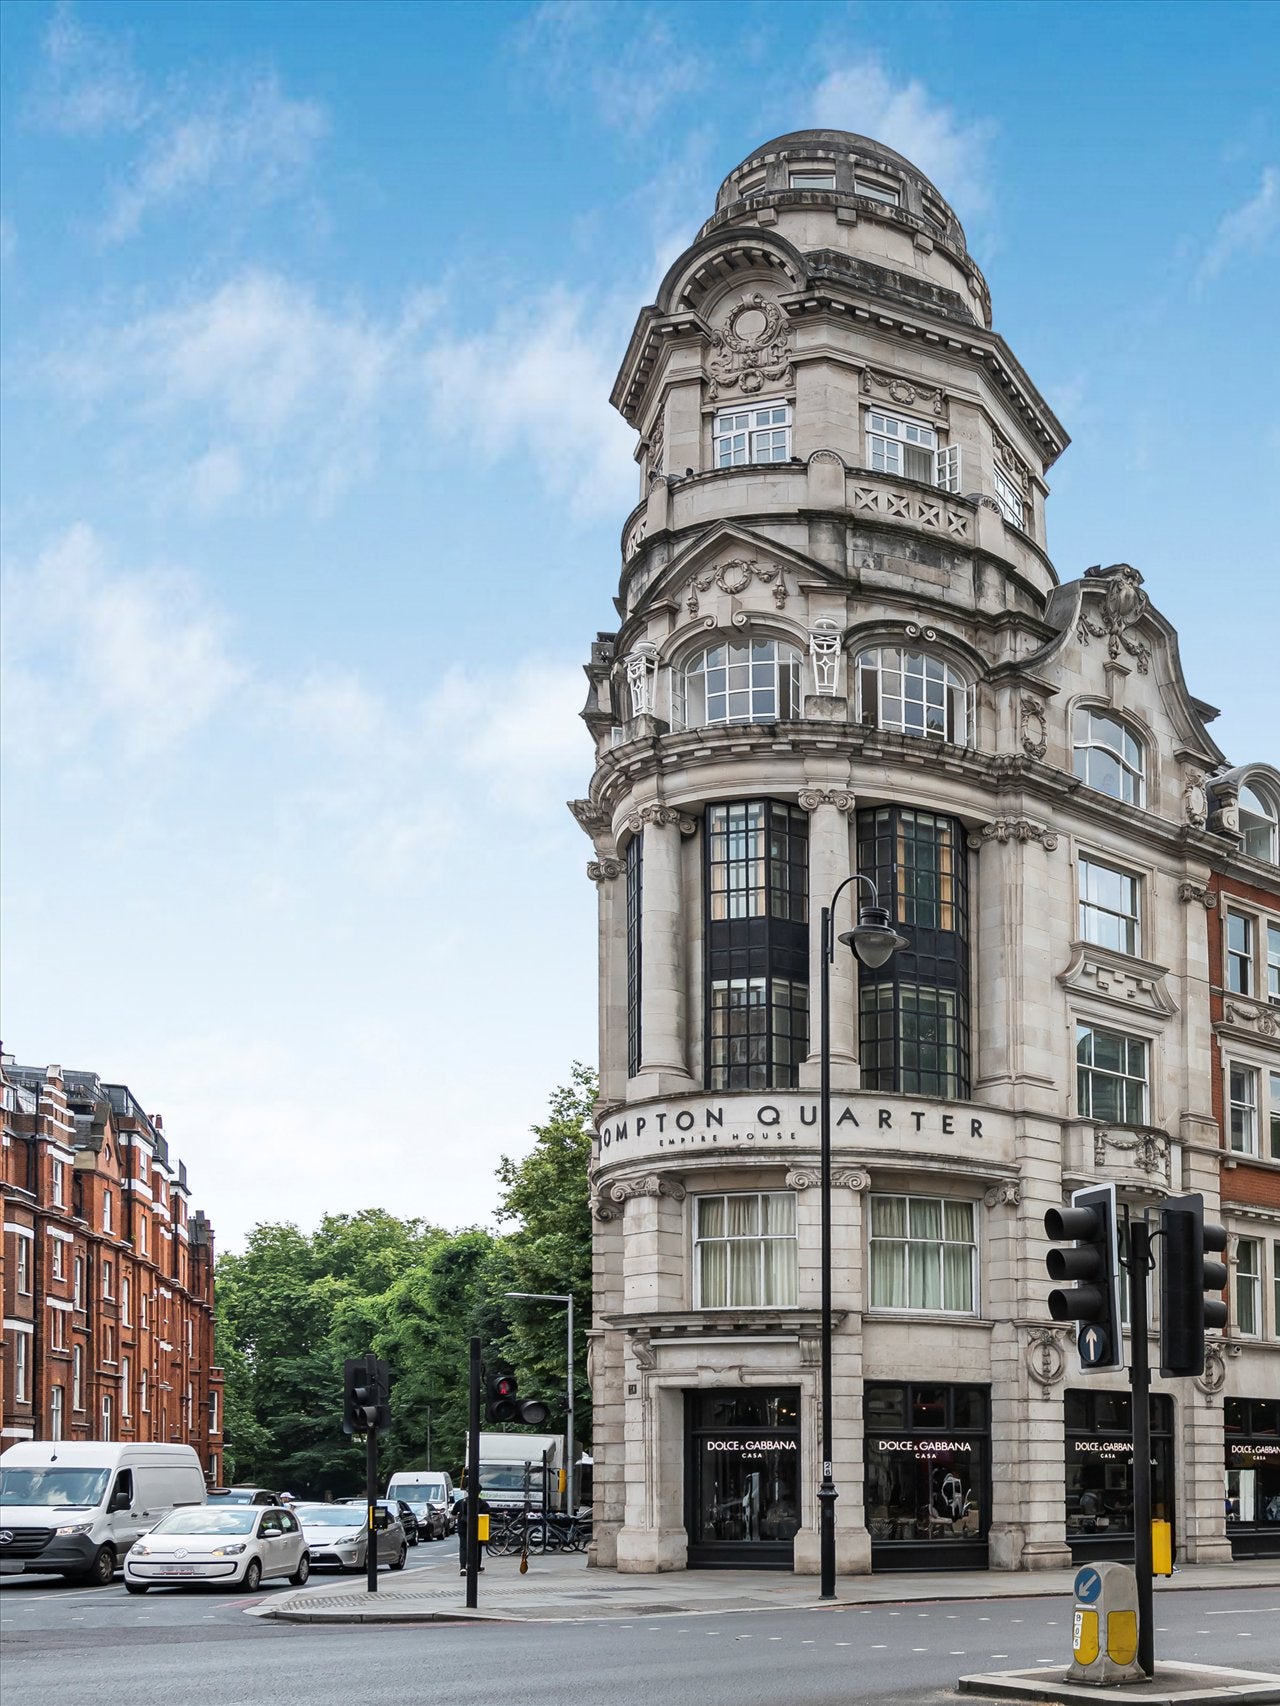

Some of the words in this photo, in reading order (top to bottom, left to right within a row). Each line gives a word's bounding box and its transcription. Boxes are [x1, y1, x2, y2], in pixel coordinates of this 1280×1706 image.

[599, 1107, 723, 1151] OMPTON
[757, 1105, 983, 1138] QUARTER
[659, 1135, 718, 1147] EMPIRE
[732, 1132, 796, 1140] HOUSE
[707, 1441, 739, 1450] DOLCE
[745, 1441, 797, 1450] GABBANA
[879, 1441, 913, 1450] DOLCE
[919, 1441, 971, 1451] GABBANA
[1075, 1442, 1099, 1451] DOLCE
[1103, 1442, 1134, 1451] GABBAN
[1231, 1445, 1252, 1453] DOLCE
[825, 1463, 831, 1476] 26
